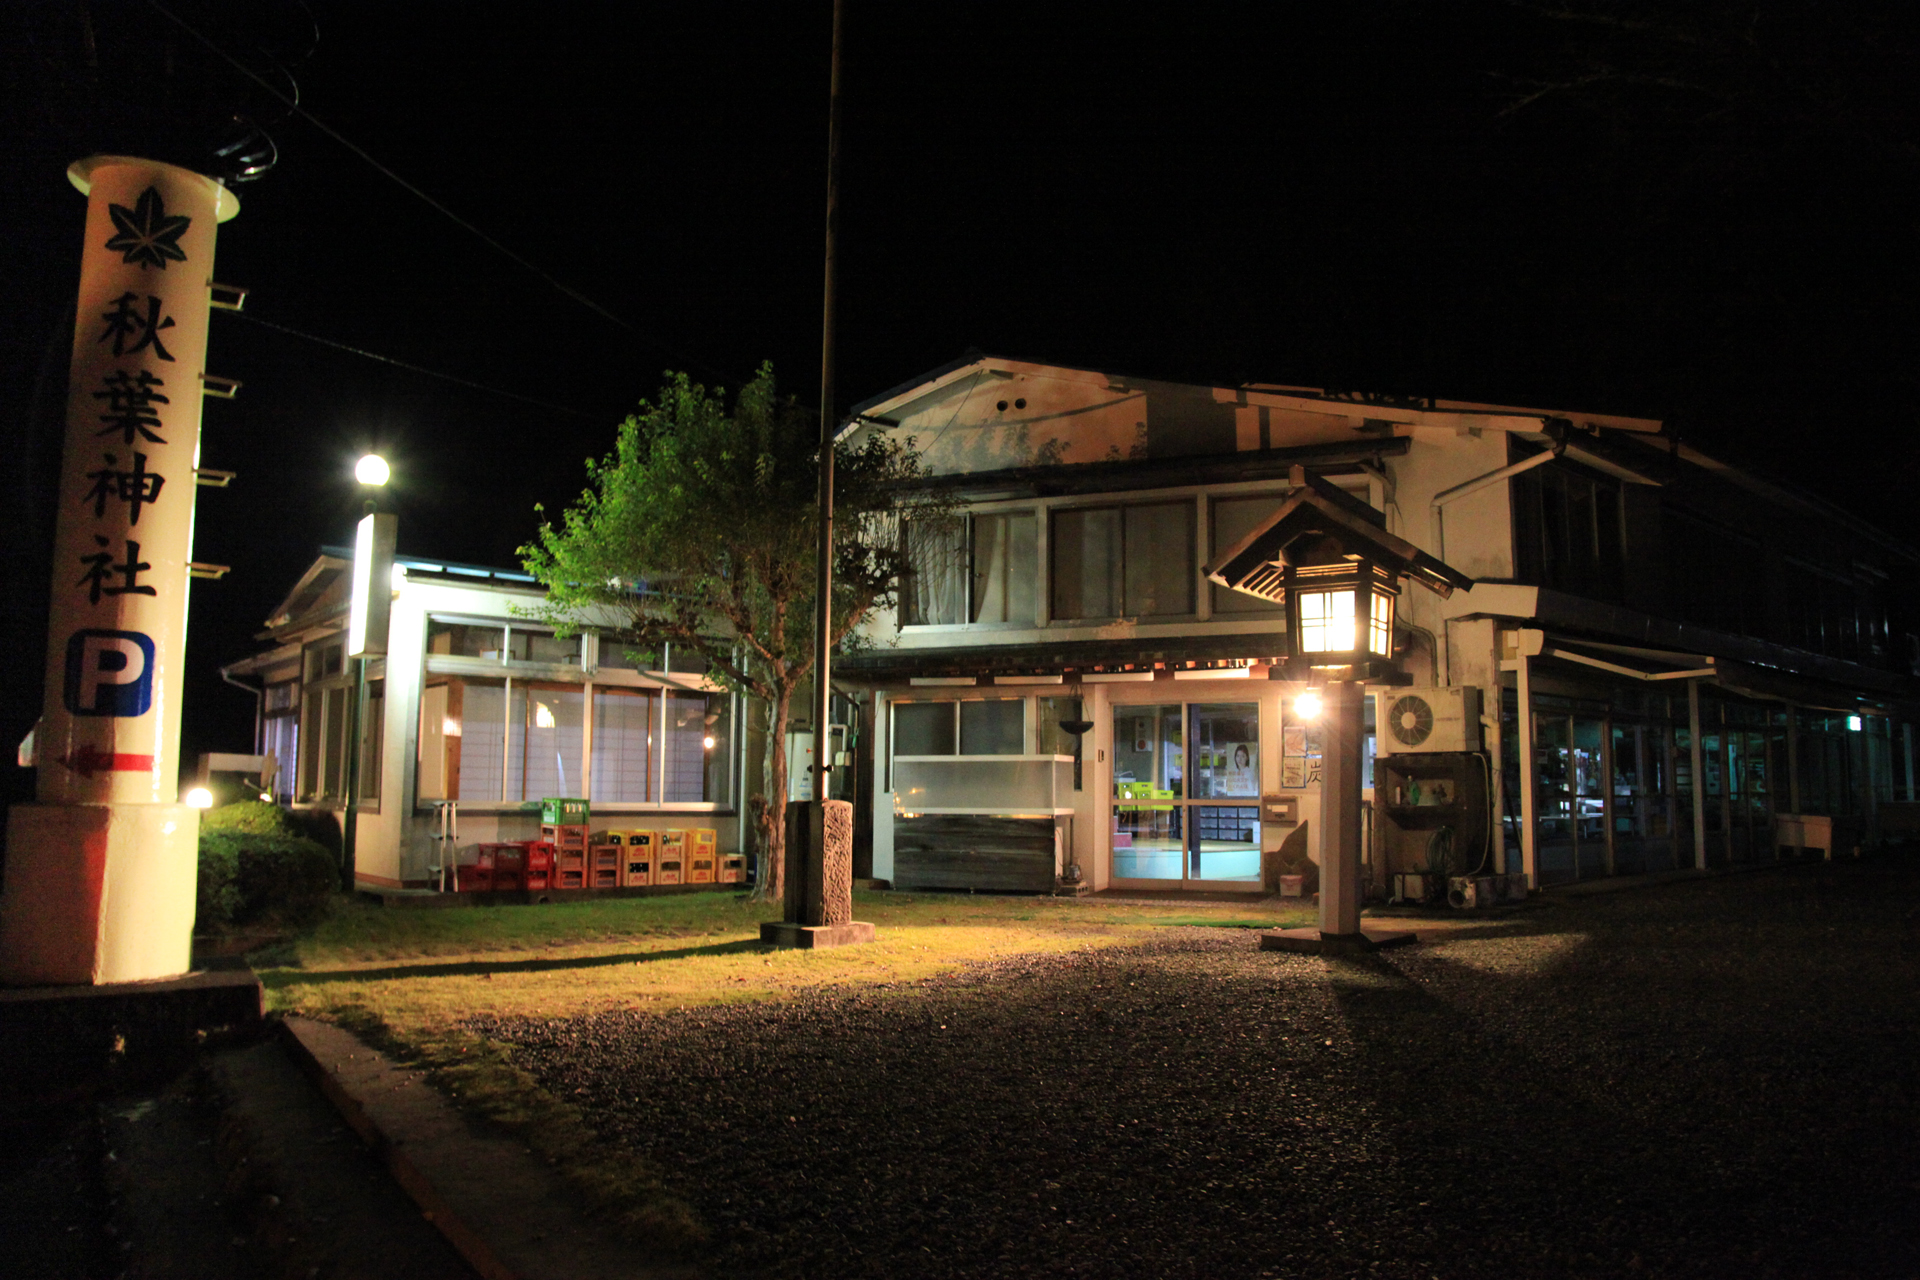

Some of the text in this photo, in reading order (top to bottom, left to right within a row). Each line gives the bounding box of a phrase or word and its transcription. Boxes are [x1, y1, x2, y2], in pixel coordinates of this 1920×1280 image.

[76, 291, 176, 605] 秋葉神社
[79, 636, 145, 709] P
